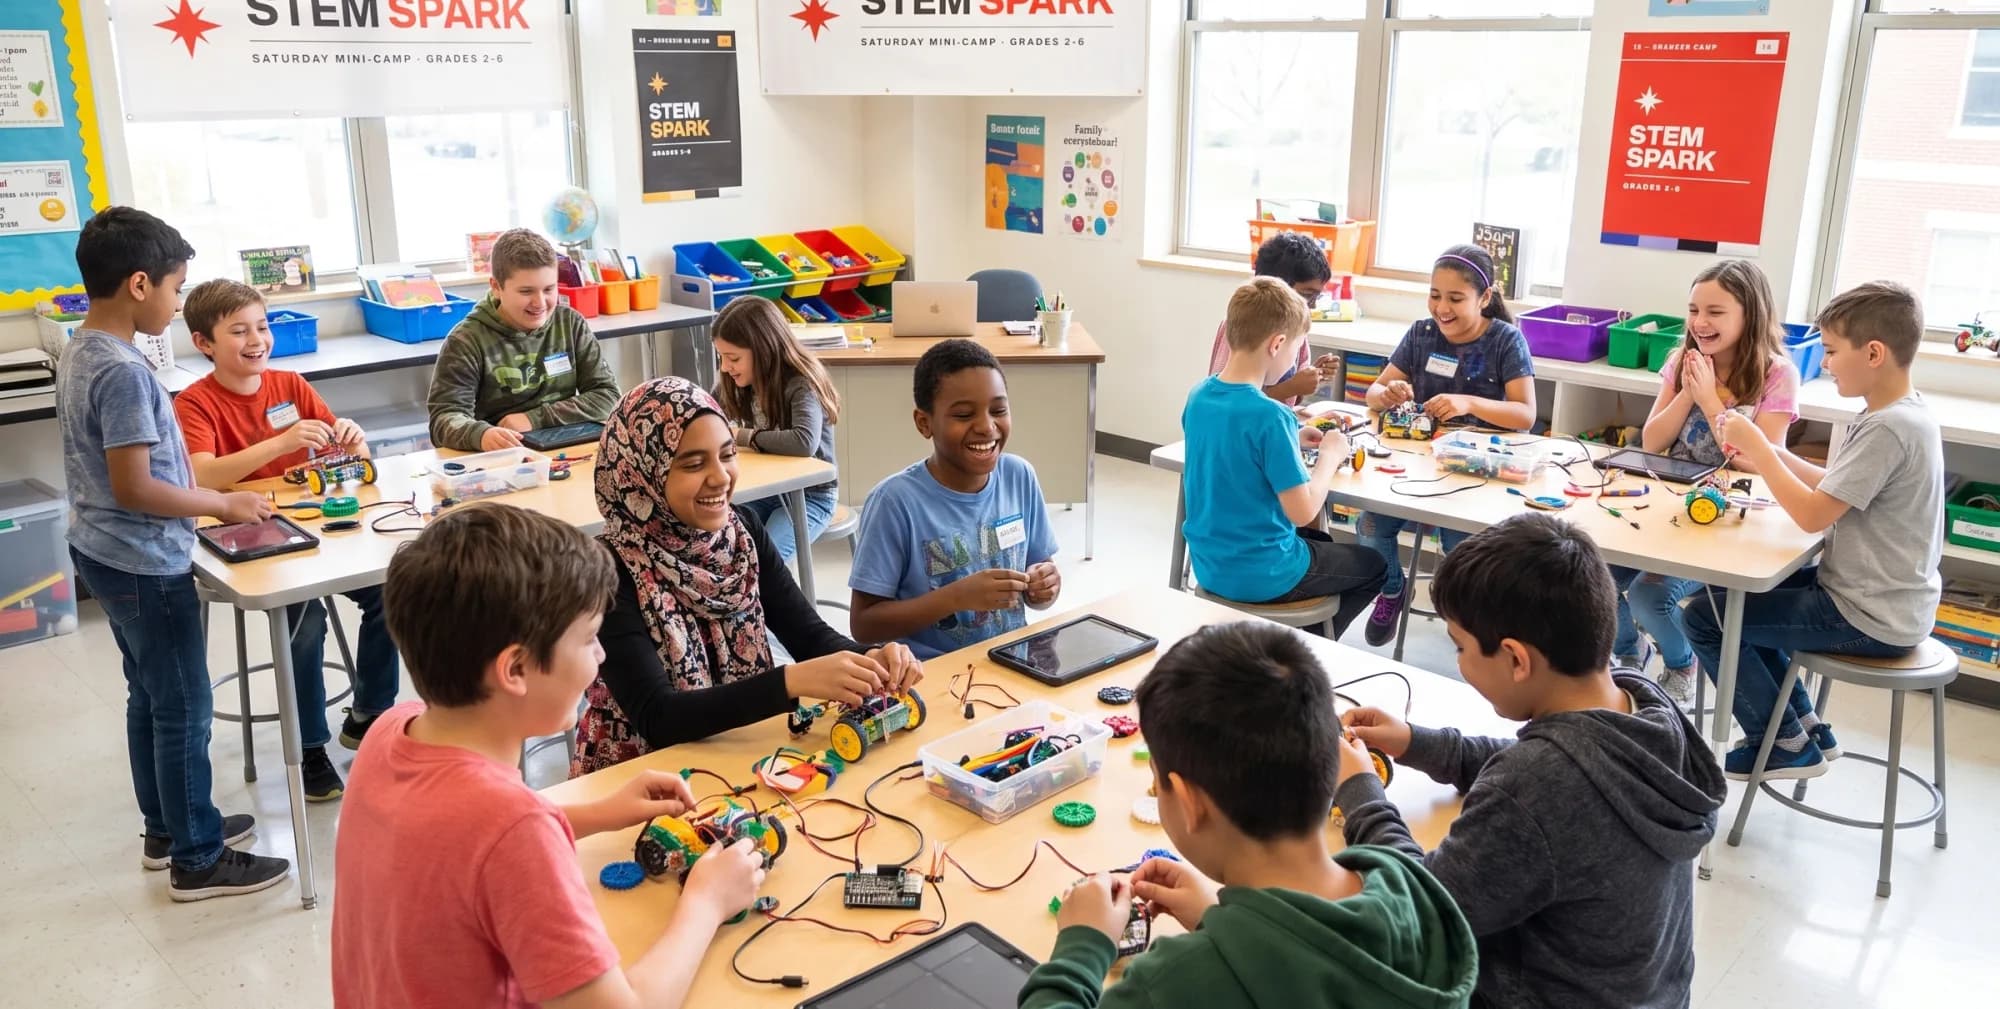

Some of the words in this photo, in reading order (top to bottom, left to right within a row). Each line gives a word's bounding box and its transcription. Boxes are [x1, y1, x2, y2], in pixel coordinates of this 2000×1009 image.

[388, 0, 530, 29] SPARK
[861, 38, 924, 46] SATURDAY
[929, 38, 996, 46] MINI-CAMP
[1009, 37, 1060, 46] GRADES
[1064, 37, 1085, 46] 2-6
[252, 53, 329, 64] SATURDAY
[335, 54, 411, 64] MINI-CAMP
[426, 54, 478, 64] GRADES
[483, 54, 504, 63] 2-6
[649, 102, 700, 119] STEM
[650, 120, 711, 138] SPARK
[1074, 124, 1103, 137] Family
[1629, 124, 1705, 148] STEM
[1626, 147, 1717, 172] SPARK
[1622, 182, 1661, 192] GRADES
